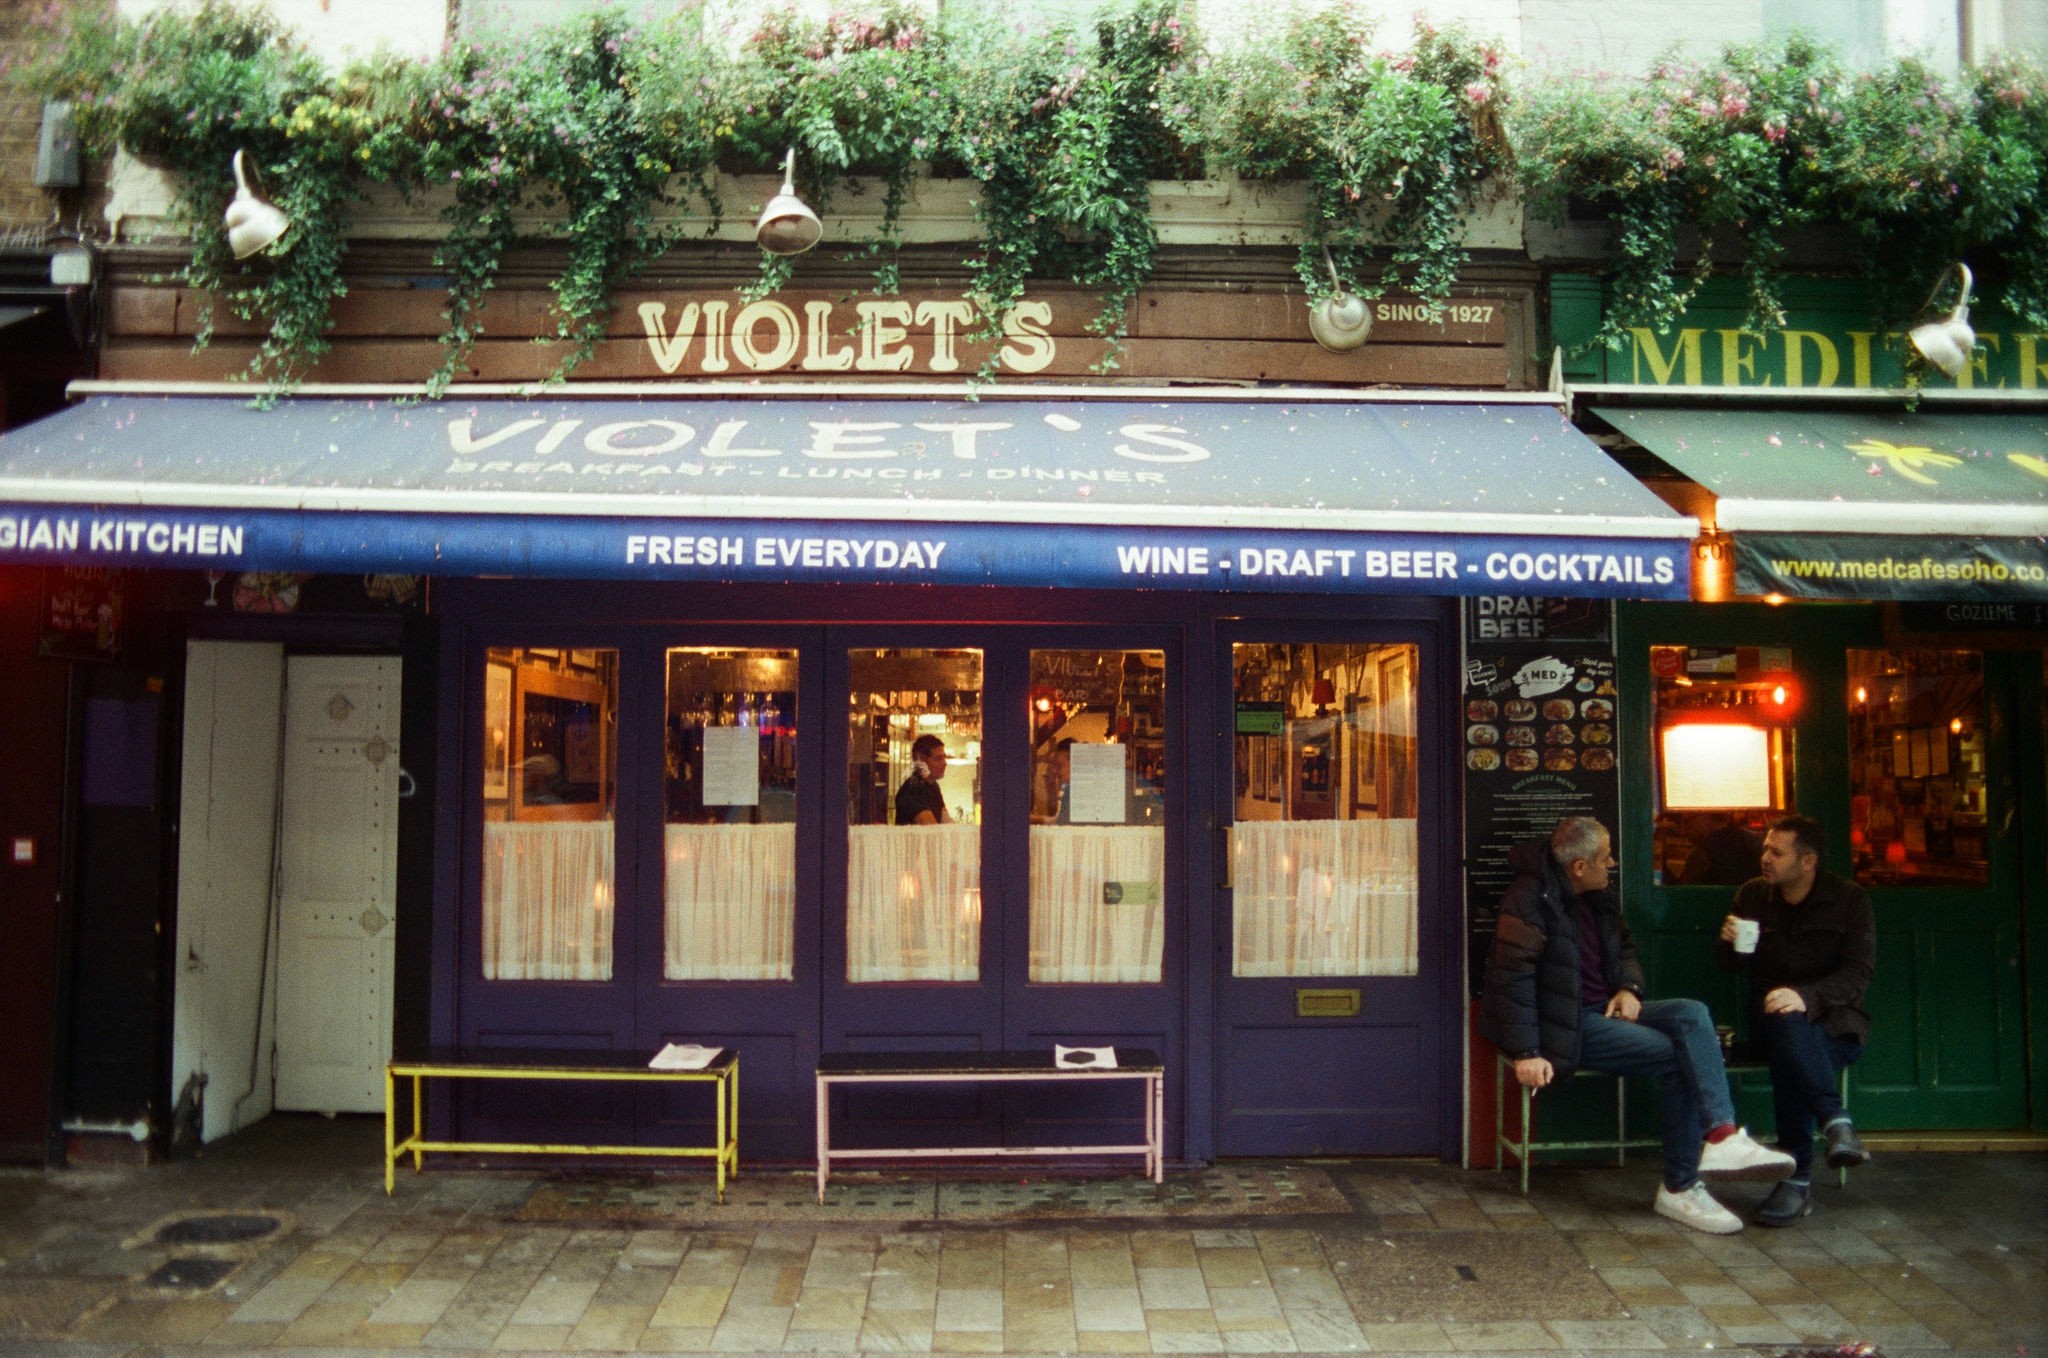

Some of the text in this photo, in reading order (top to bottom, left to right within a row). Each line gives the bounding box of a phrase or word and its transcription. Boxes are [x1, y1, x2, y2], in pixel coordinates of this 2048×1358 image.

[1449, 305, 1494, 323] 1927
[447, 414, 1211, 463] VIOLET'S
[445, 459, 737, 478] BREAKFAST
[777, 467, 942, 481] LUNCH
[986, 466, 1168, 484] DINNER
[0, 517, 244, 556] GIAN KITCHEN
[626, 535, 946, 569] FRESH EVERYDAY
[1117, 546, 1209, 575] WINE
[1239, 548, 1356, 577] DRAFT
[1365, 550, 1459, 579] BEER
[1485, 553, 1675, 585] COCKTAILS
[1531, 669, 1558, 680] MED
